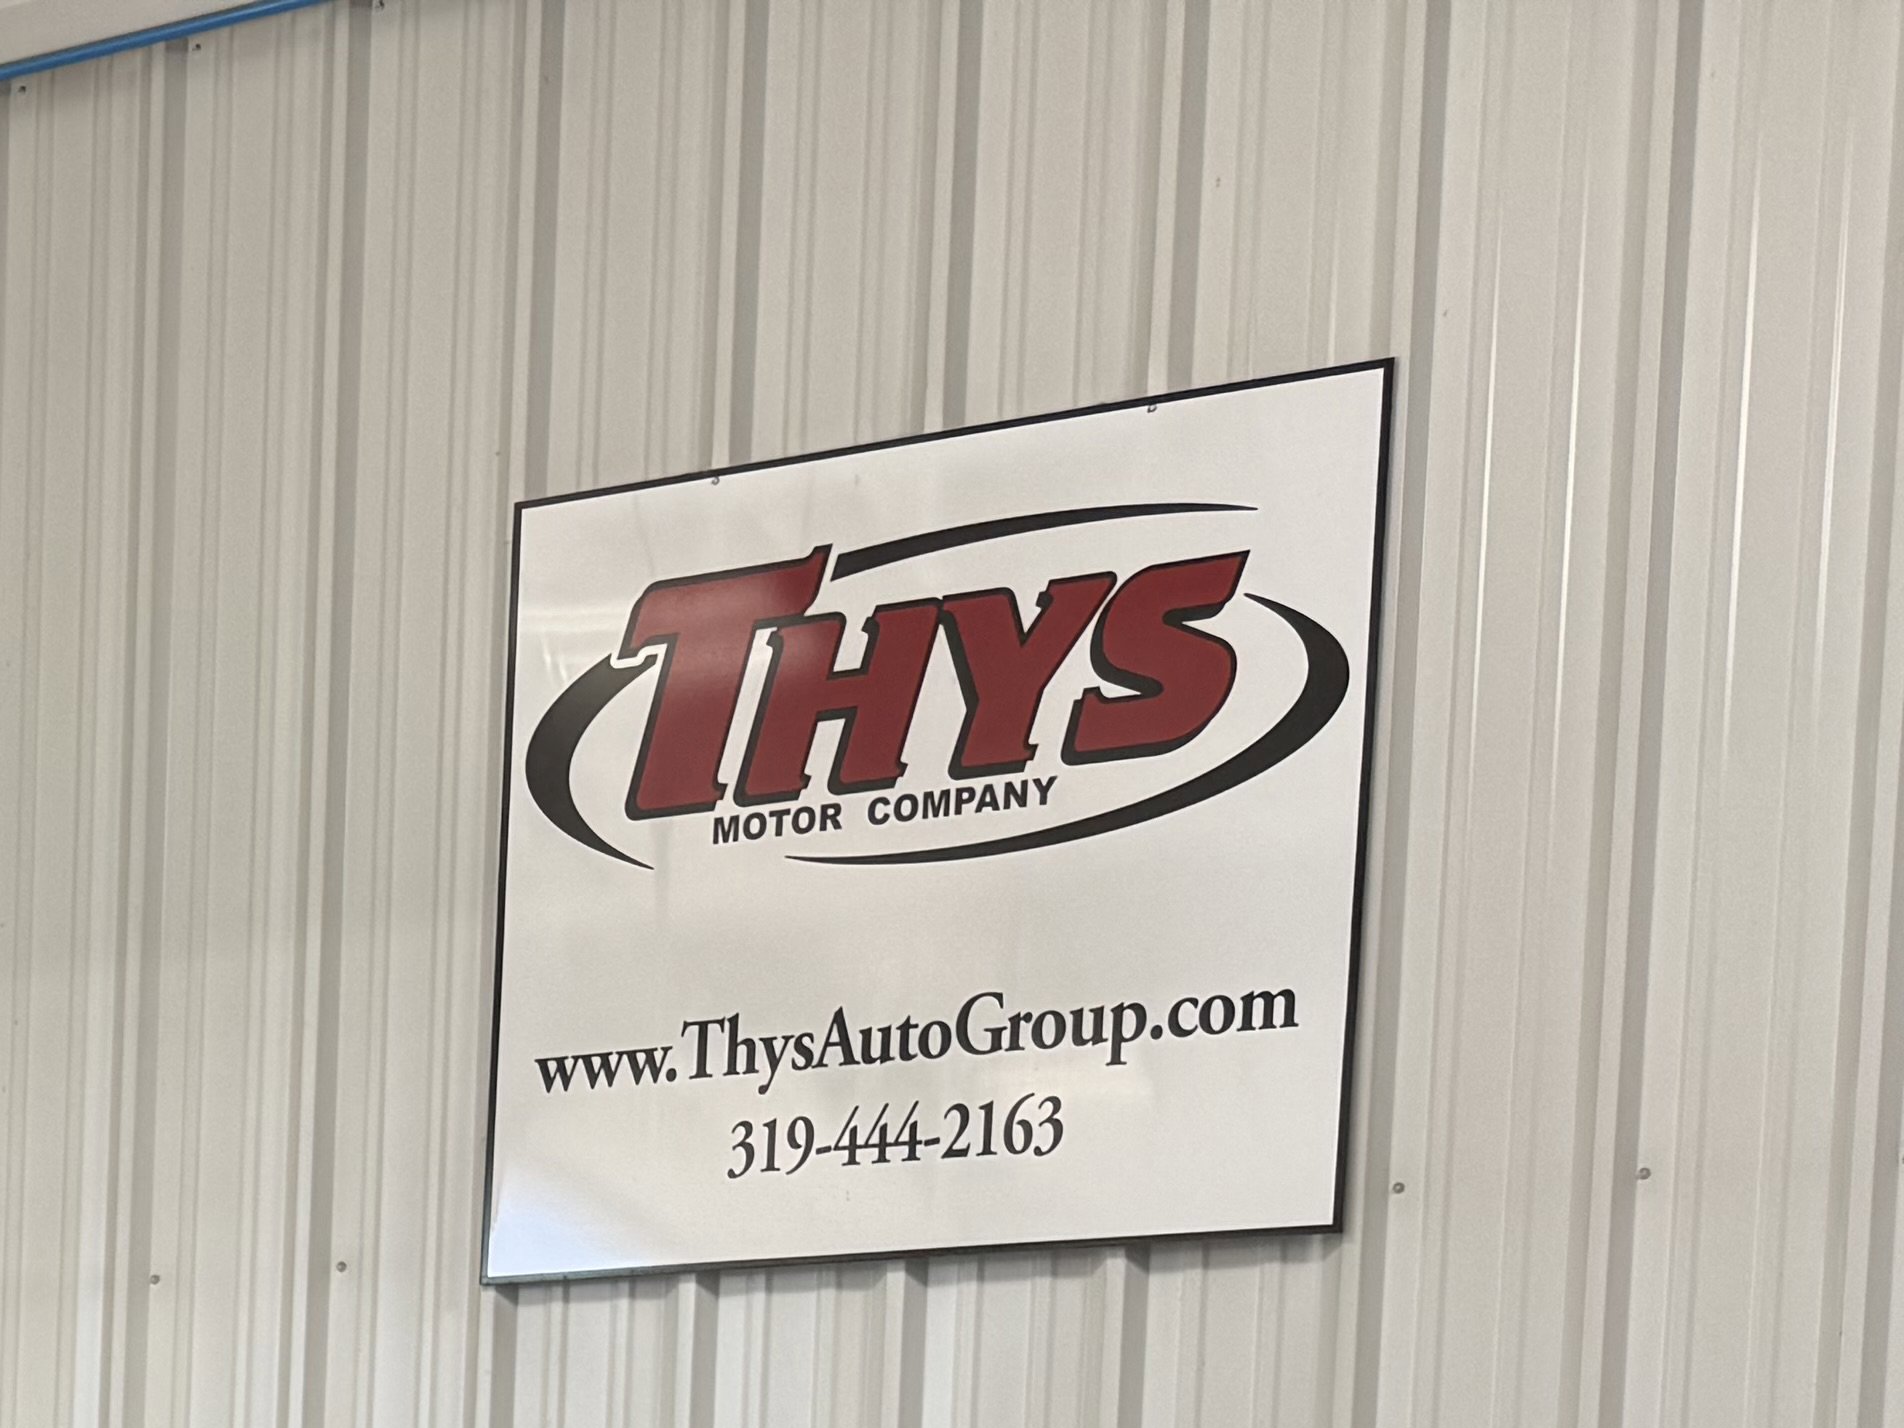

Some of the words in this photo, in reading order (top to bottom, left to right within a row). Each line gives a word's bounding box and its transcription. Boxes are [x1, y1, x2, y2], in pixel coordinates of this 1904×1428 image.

[617, 543, 1251, 822] THYS
[711, 802, 844, 846] MOTOR
[867, 775, 1058, 827] COMPANY
[534, 986, 1299, 1094] www.ThysAutoGroup.com
[727, 1094, 1065, 1179] 319-444-2163
